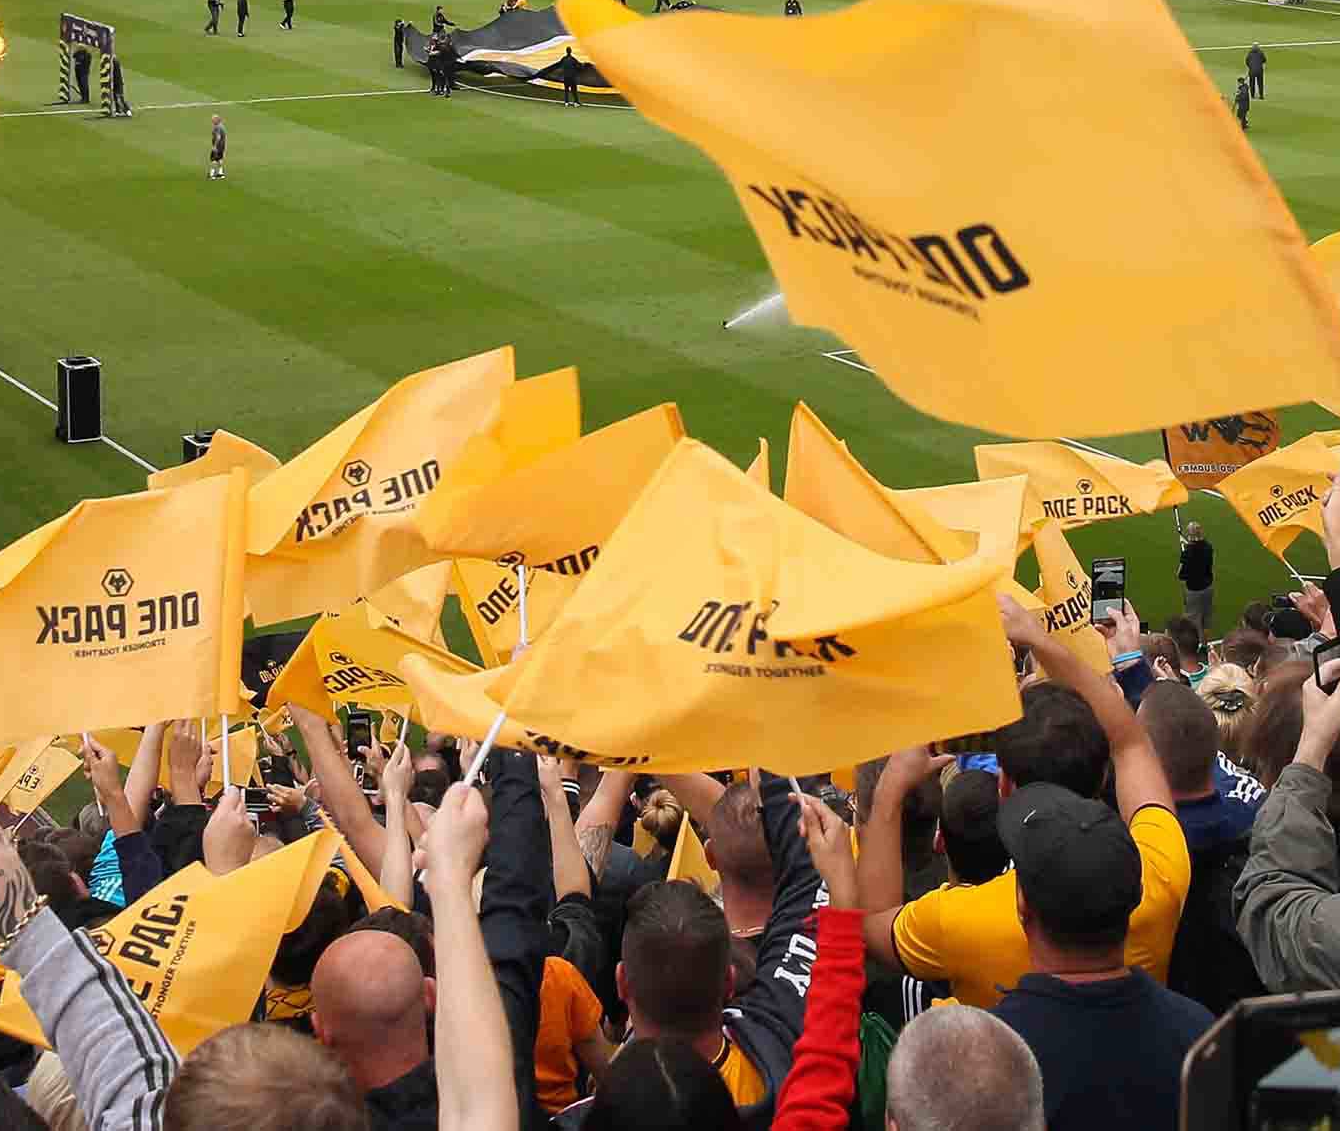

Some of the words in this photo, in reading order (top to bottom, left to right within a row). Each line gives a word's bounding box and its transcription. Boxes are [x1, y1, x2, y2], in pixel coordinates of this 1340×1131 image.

[1042, 496, 1077, 520] ONE
[1082, 494, 1134, 518] PACK
[1258, 501, 1287, 527] ONE
[1286, 484, 1320, 512] PACK
[477, 575, 519, 625] ONE
[755, 664, 827, 678] TOGETHER
[119, 895, 189, 969] PAC
[151, 968, 178, 1021] STRONGER
[171, 918, 198, 969] TOGETHER
